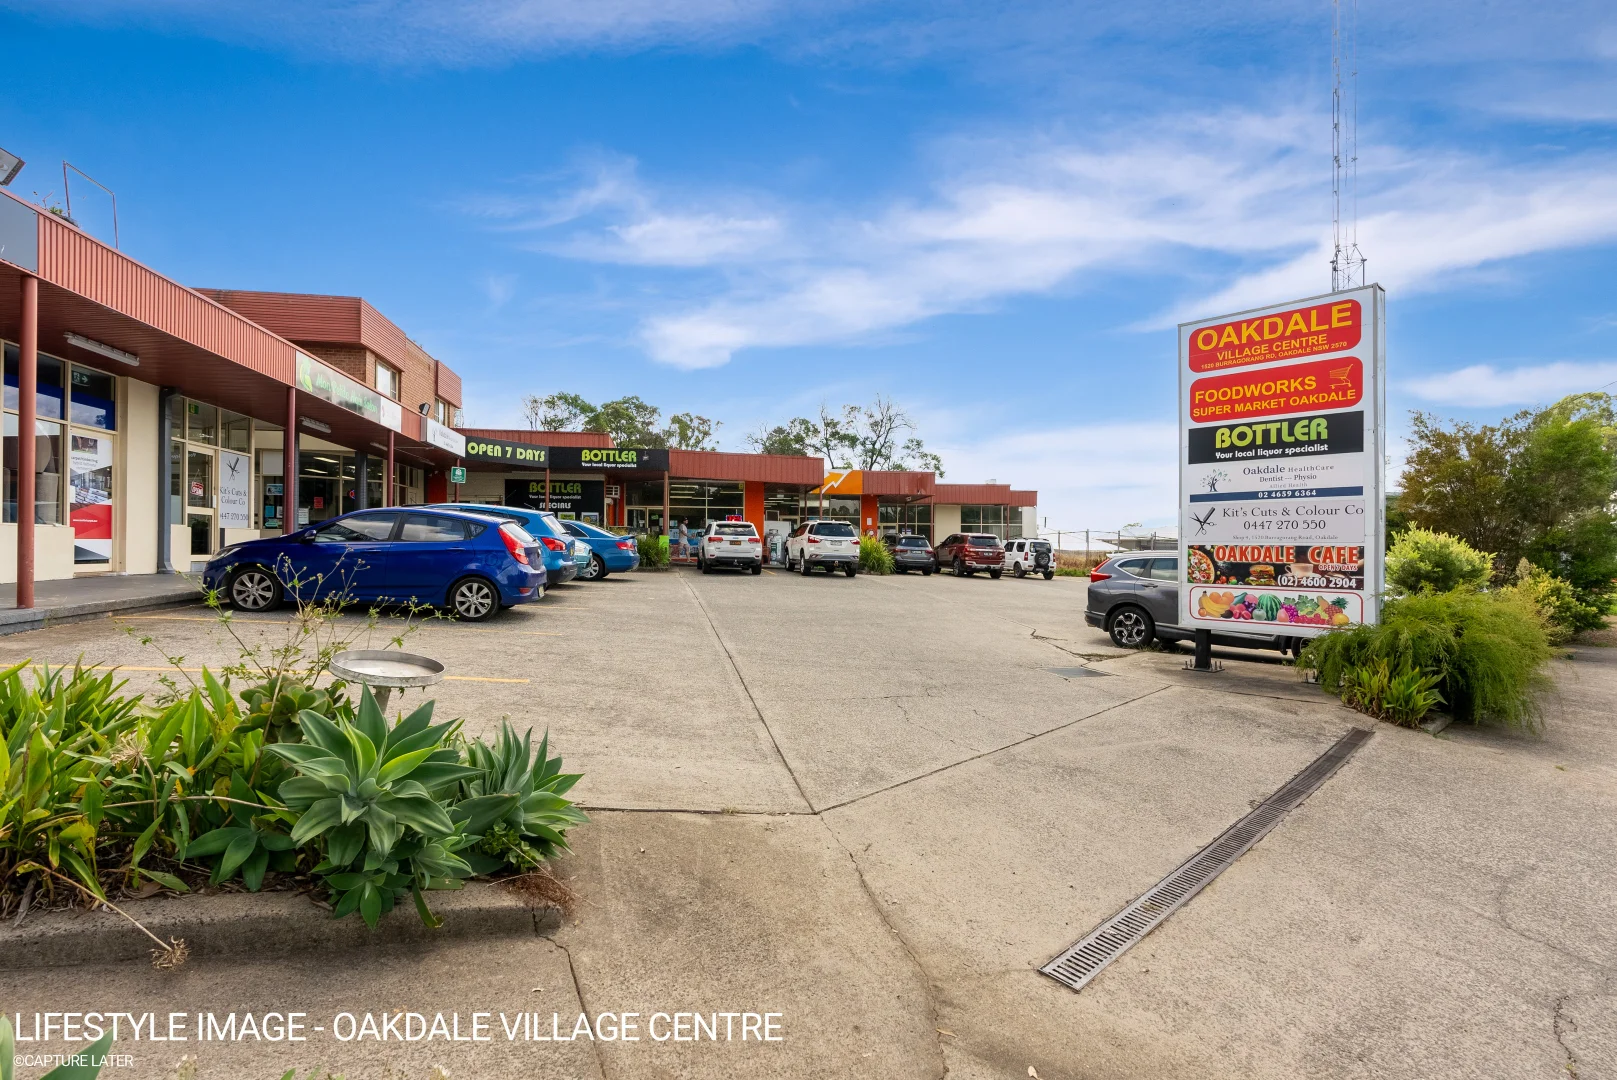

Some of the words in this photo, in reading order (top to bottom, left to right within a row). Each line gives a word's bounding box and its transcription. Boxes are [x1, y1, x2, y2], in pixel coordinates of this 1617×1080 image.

[1197, 303, 1352, 351] OAKDALE
[1215, 355, 1264, 368] BURRAGORANG
[1278, 346, 1312, 357] OAKDALE
[1313, 344, 1330, 352] NSW
[1331, 341, 1348, 349] 2570
[1217, 344, 1269, 361] VILLAGE
[1273, 334, 1328, 351] CENTRE
[1195, 376, 1317, 403] FOODWORKS
[1193, 405, 1231, 417] SUPER
[1234, 398, 1286, 413] MARKET
[1289, 389, 1356, 406] OAKDALE
[1215, 417, 1328, 449] BOTTLER
[467, 442, 502, 457] OPEN
[505, 446, 513, 458] 7
[516, 447, 545, 462] DAYS
[581, 449, 637, 462] BOTTLER
[1235, 449, 1255, 458] local
[1257, 448, 1282, 457] liquor
[1284, 444, 1329, 455] specialist
[1243, 465, 1286, 475] Oakdale
[1288, 465, 1335, 473] HealthCare
[231, 488, 242, 496] Cuts
[529, 482, 581, 493] BOTTLER
[221, 496, 238, 505] Colour
[230, 512, 239, 520] 270
[1222, 507, 1248, 518] Kit's
[1251, 506, 1278, 517] Cuts
[1281, 507, 1291, 516] &
[1295, 505, 1341, 516] Colour
[1344, 504, 1365, 516] Co
[1243, 521, 1273, 530] 0447
[1275, 520, 1299, 529] 270
[1302, 519, 1327, 530] 550
[1213, 545, 1296, 563] OAKDALE
[1308, 545, 1359, 564] CAFE
[1277, 575, 1298, 586] (02)
[1300, 576, 1327, 587] 4600
[1328, 578, 1357, 589] 2904
